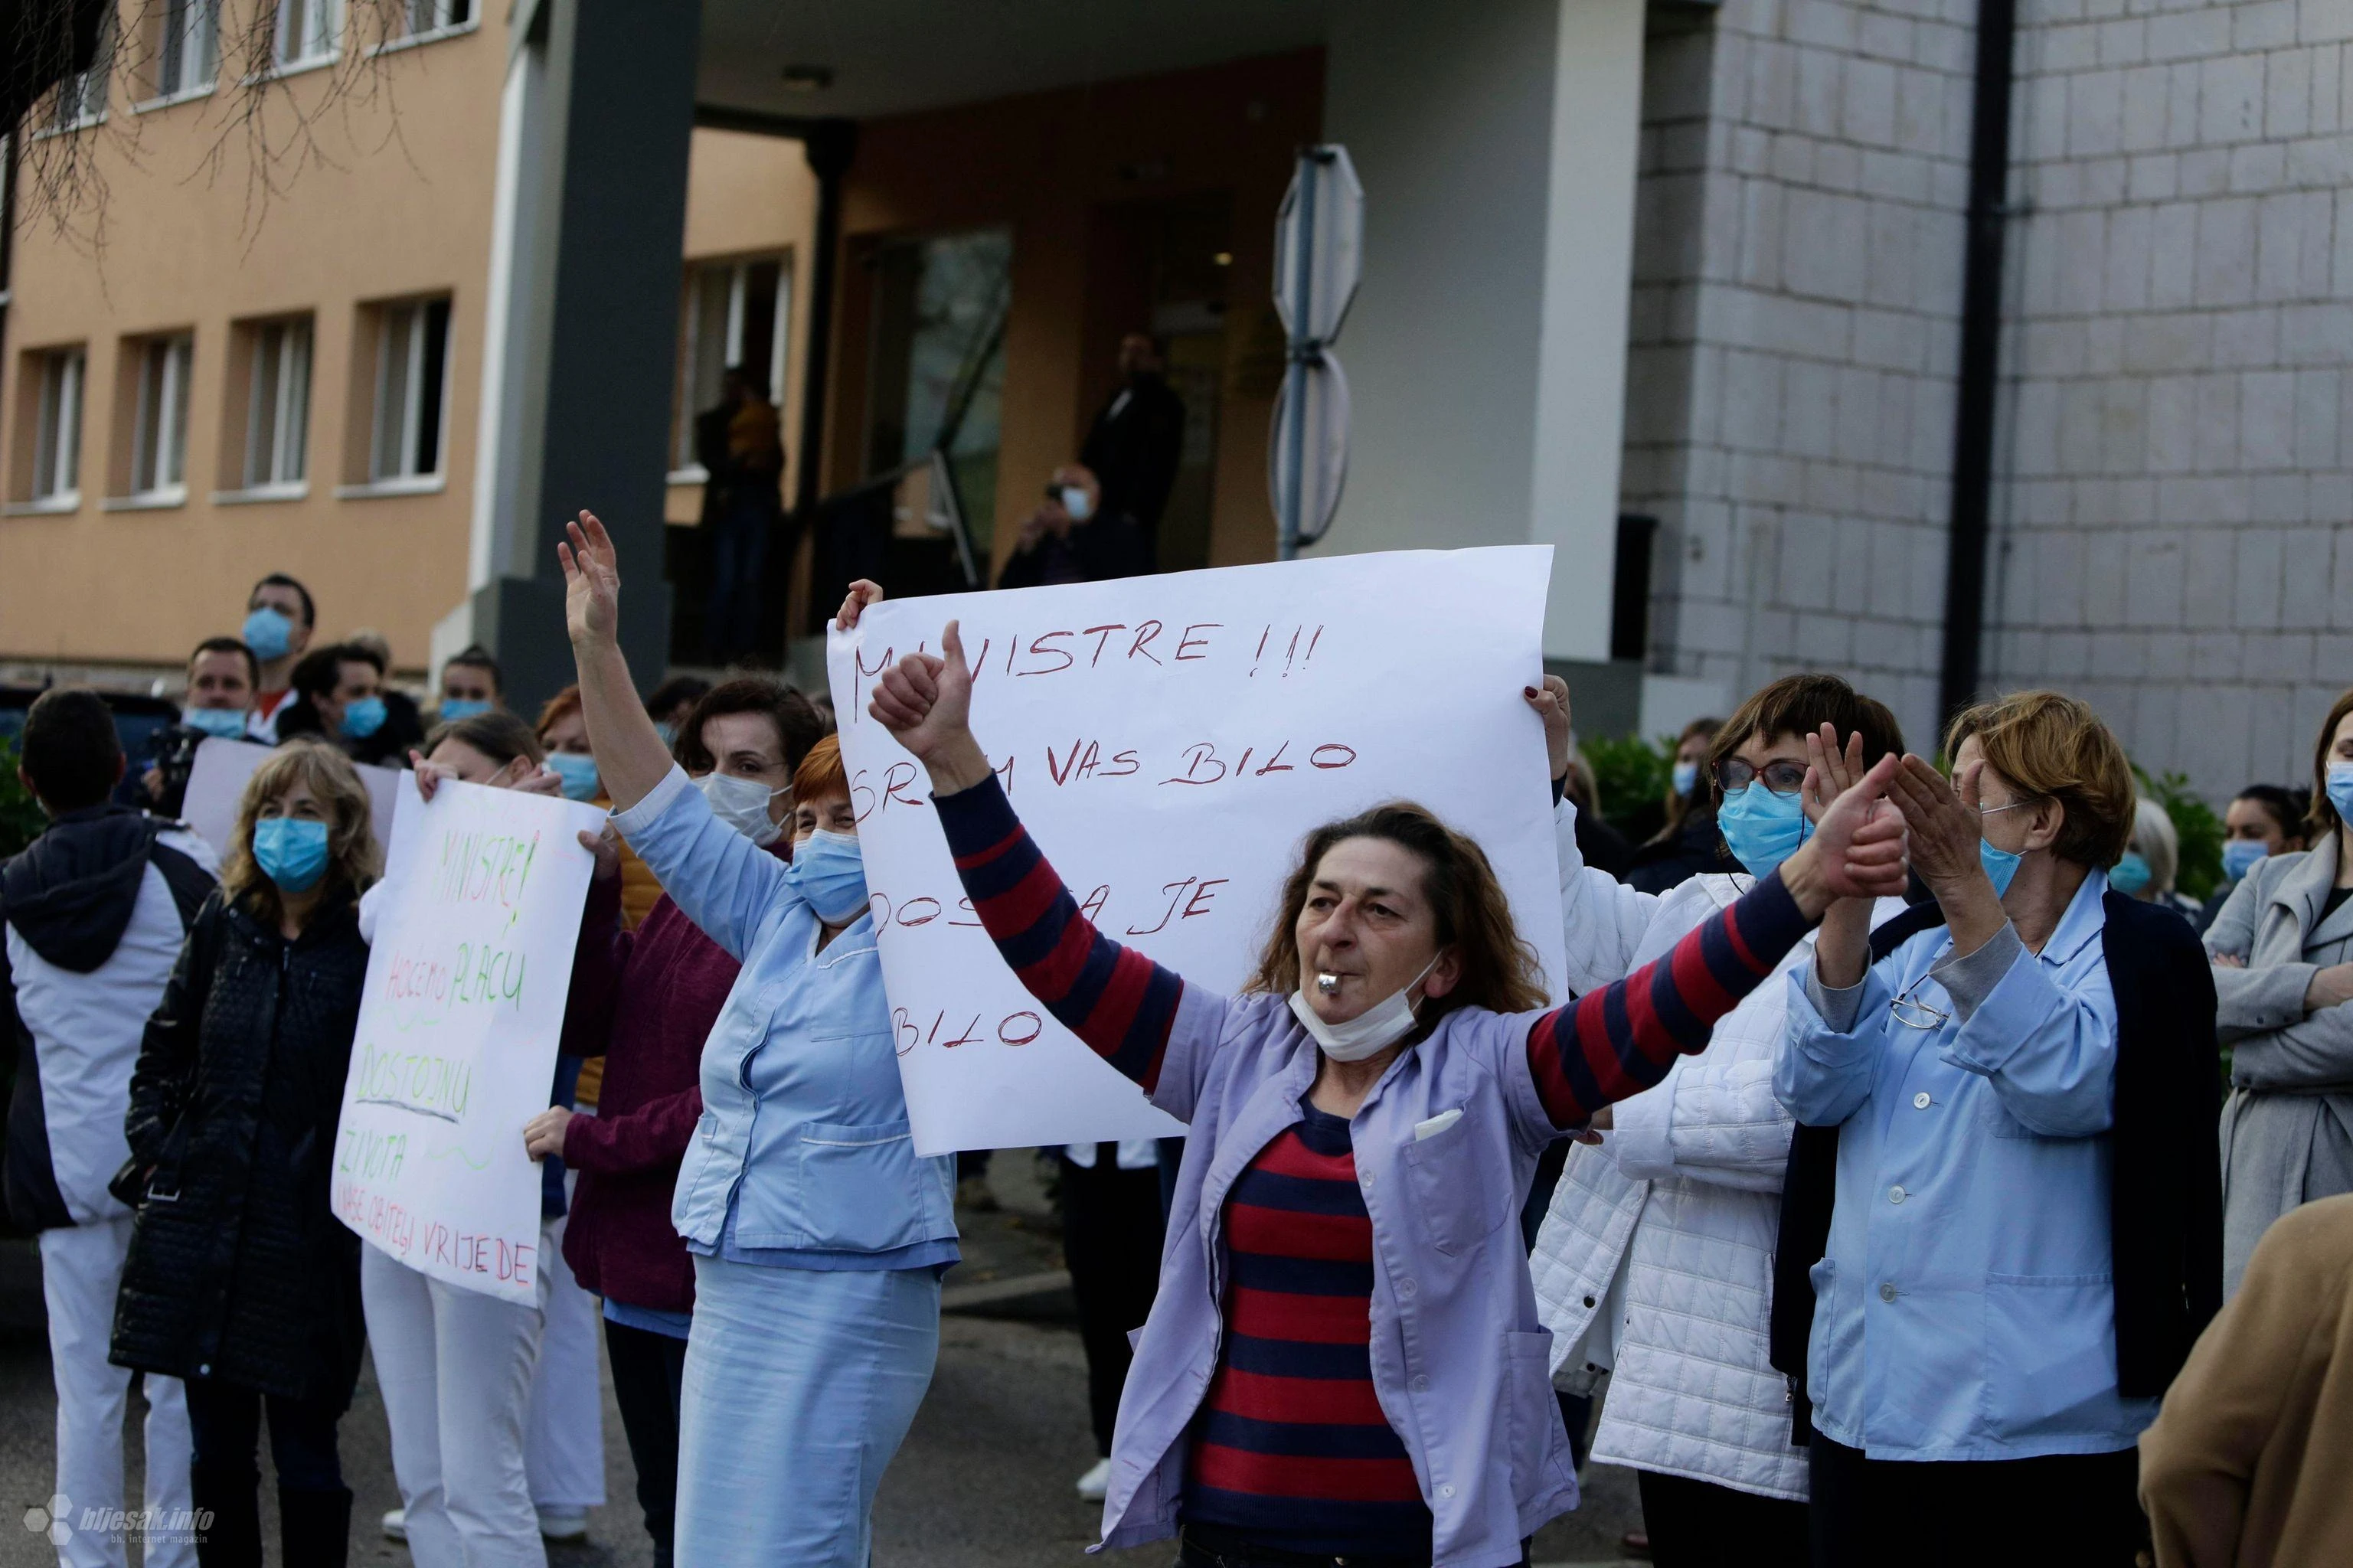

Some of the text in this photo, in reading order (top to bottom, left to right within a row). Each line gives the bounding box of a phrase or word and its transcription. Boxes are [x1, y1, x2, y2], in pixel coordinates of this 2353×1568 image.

[1047, 738, 1141, 787] VAS
[1158, 742, 1357, 786] BILO
[1127, 875, 1229, 936] JE
[891, 1007, 1043, 1057] BILO
[357, 1044, 472, 1116] DOSTOJNU
